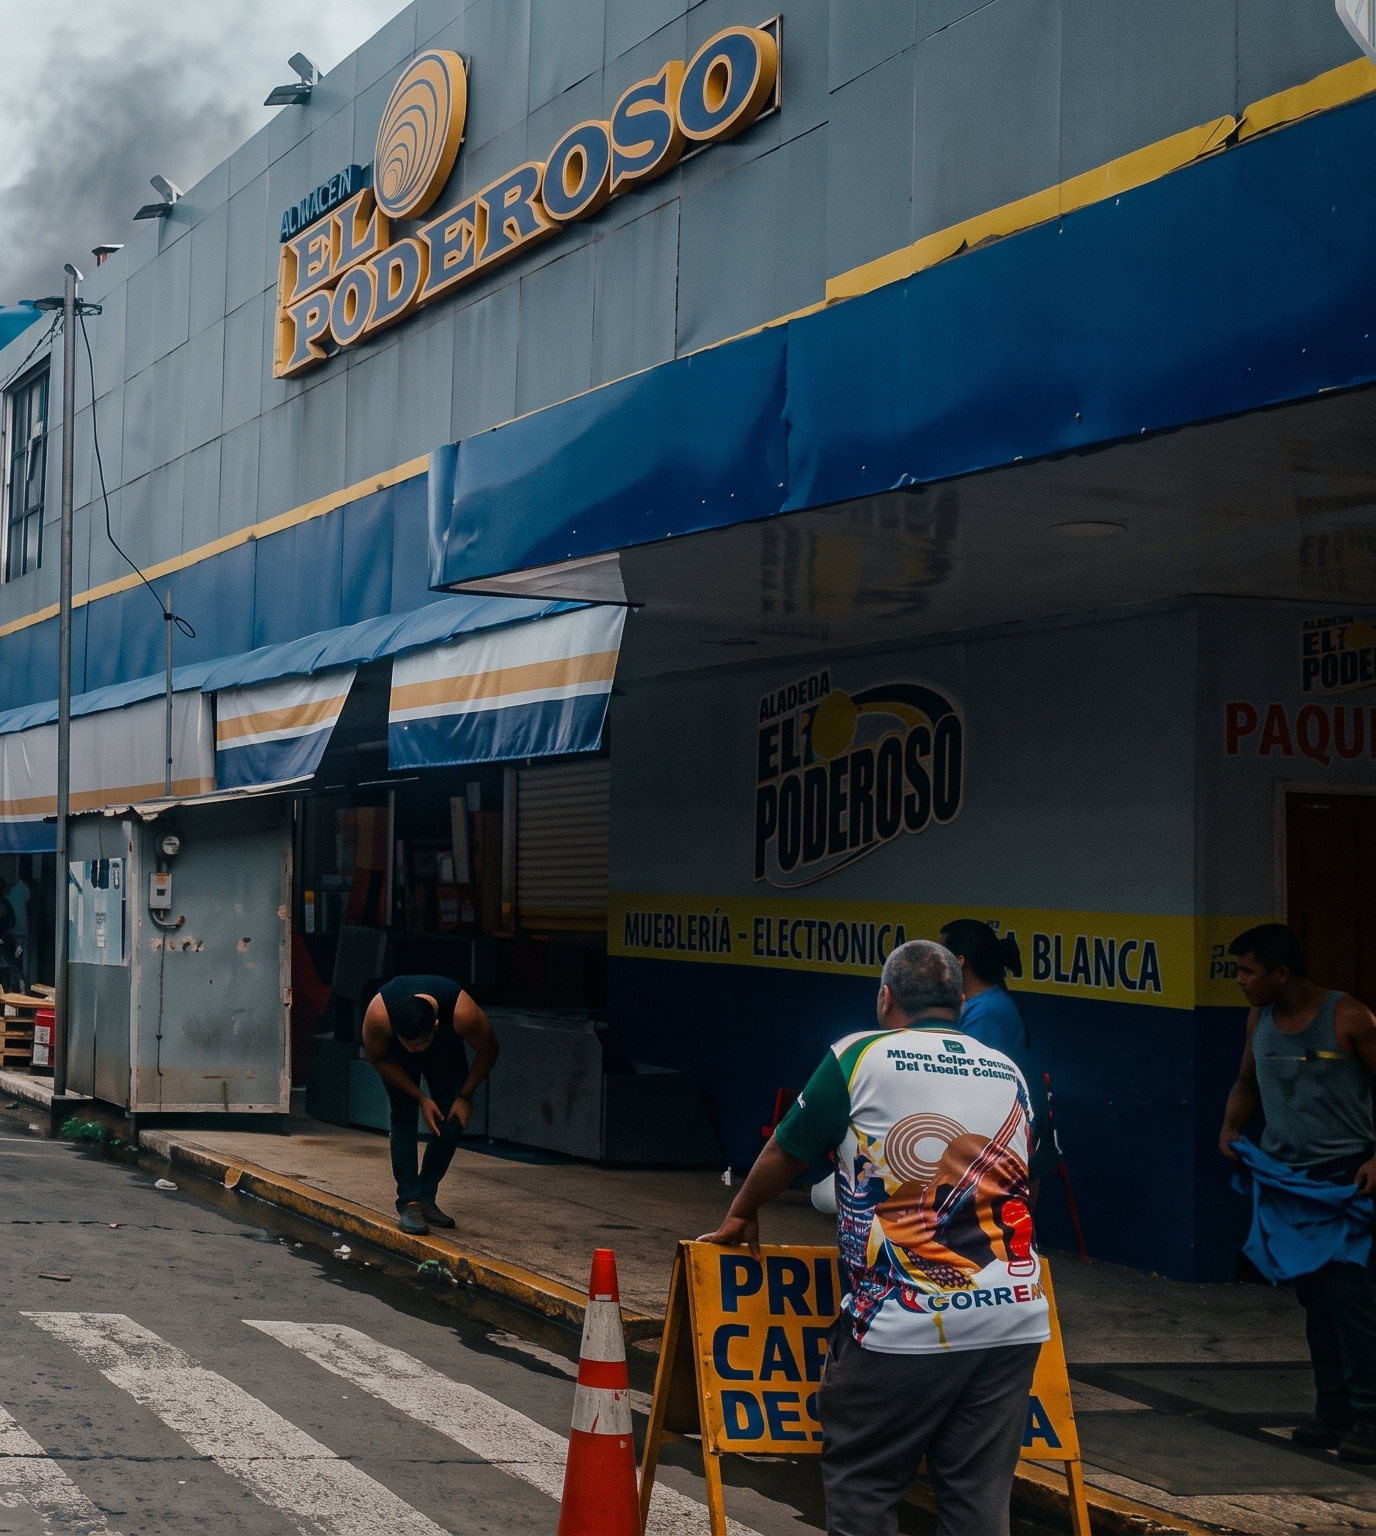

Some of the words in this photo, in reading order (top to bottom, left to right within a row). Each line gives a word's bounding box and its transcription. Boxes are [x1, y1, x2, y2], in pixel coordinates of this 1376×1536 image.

[282, 25, 774, 377] PODEROSO
[290, 188, 381, 301] EL
[1303, 647, 1376, 691] PODE
[1226, 702, 1376, 767] PAQU
[755, 713, 962, 879] PODEROSO
[624, 907, 732, 953] MUEBLERÍA
[1032, 933, 1163, 992] BLANCA
[719, 1254, 848, 1316] PRI
